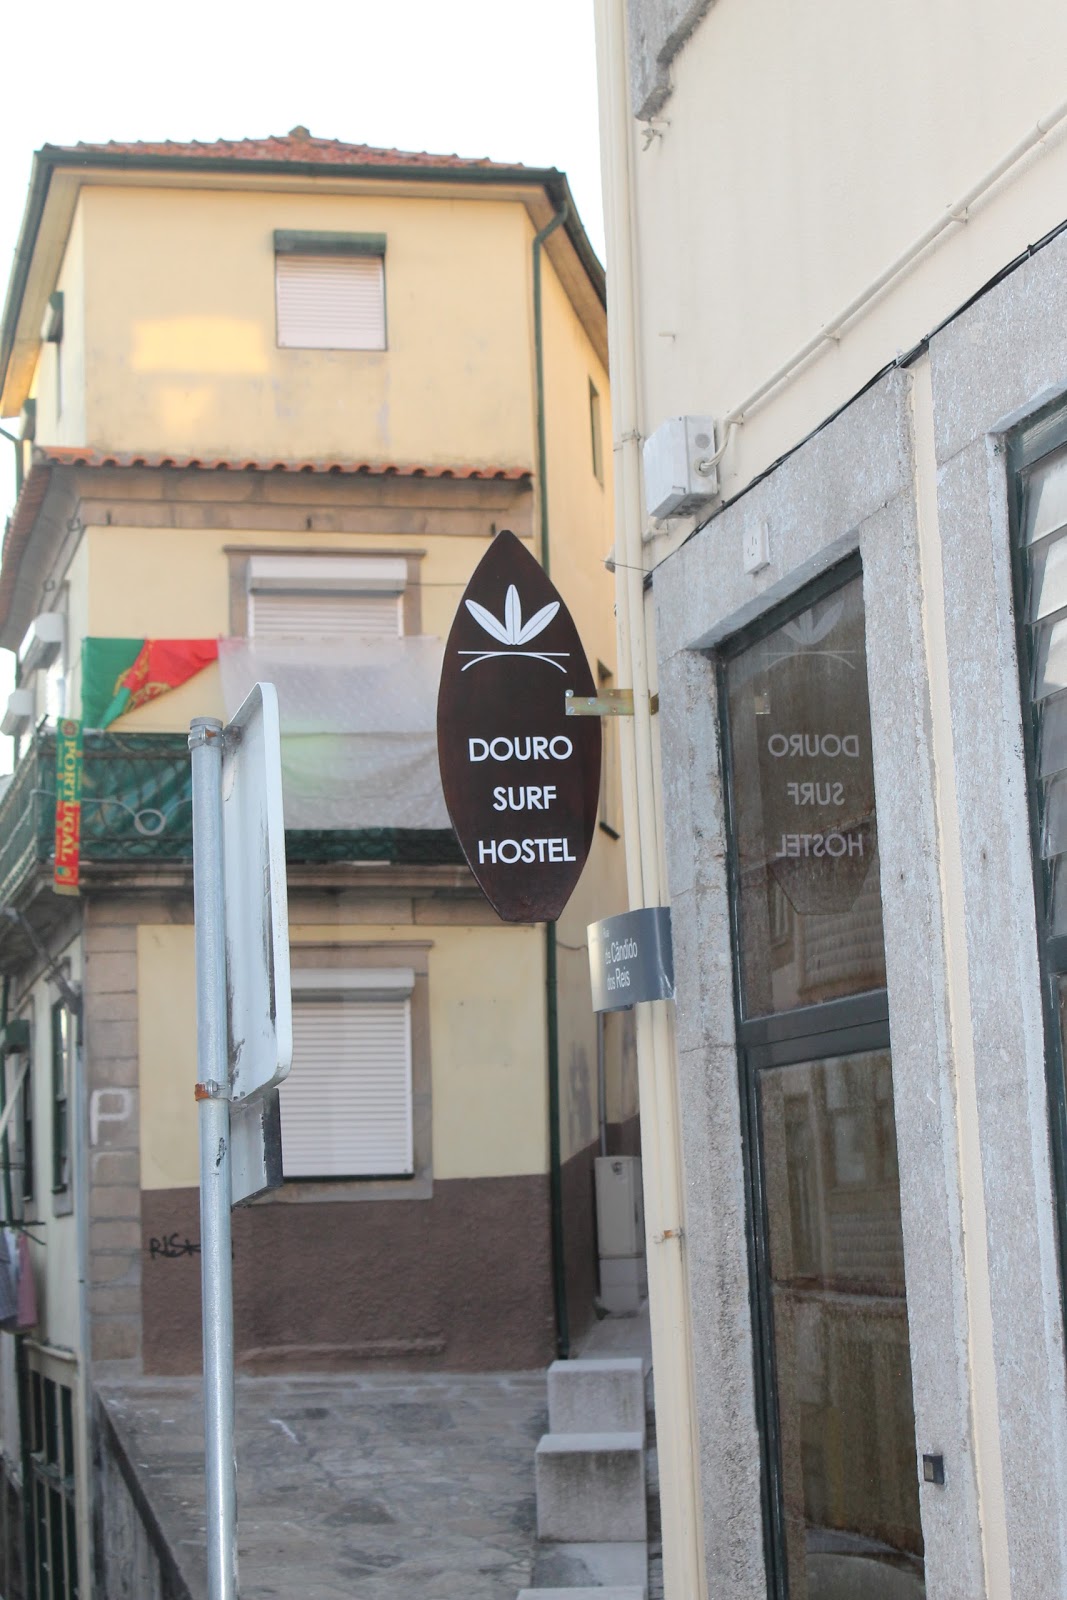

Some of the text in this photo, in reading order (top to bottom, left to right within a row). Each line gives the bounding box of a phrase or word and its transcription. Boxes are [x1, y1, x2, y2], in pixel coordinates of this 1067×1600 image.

[468, 735, 573, 762] DOURO
[62, 740, 77, 861] PORTUGAL
[492, 785, 557, 811] SURF
[478, 837, 576, 865] HOSTEL
[612, 938, 638, 963] Cândido
[616, 966, 631, 988] Reis
